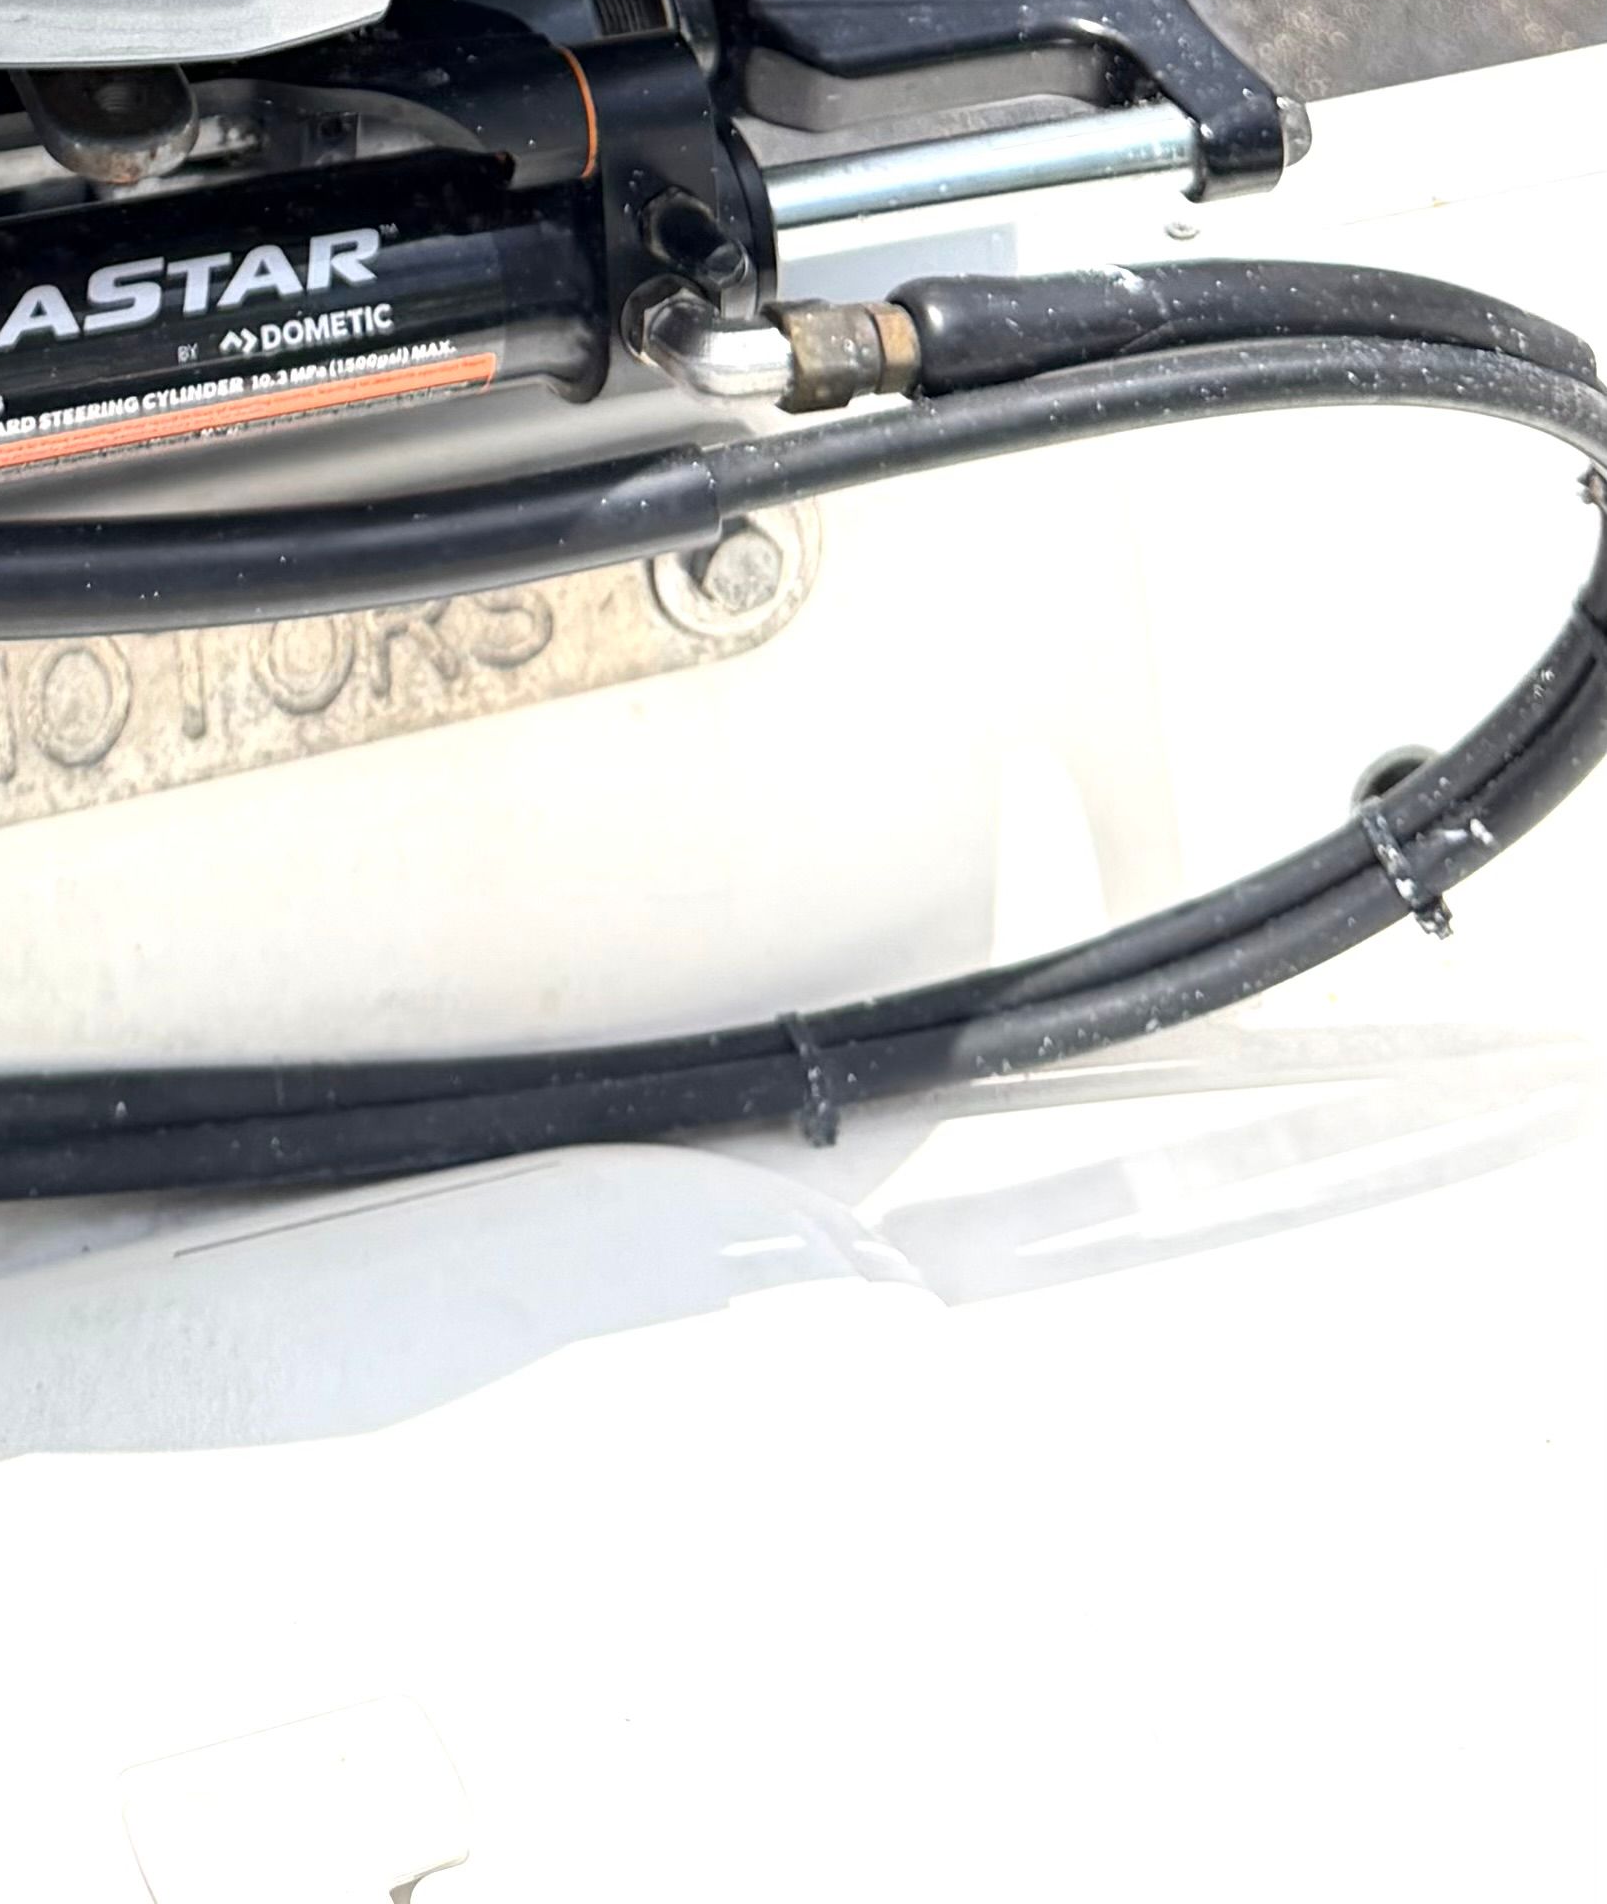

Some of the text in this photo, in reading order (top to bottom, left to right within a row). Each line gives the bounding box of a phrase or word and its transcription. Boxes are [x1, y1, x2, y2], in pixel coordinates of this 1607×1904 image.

[178, 303, 394, 364] BY DOMETIC
[38, 395, 140, 430] STEERING
[141, 375, 244, 410] CYLINDER
